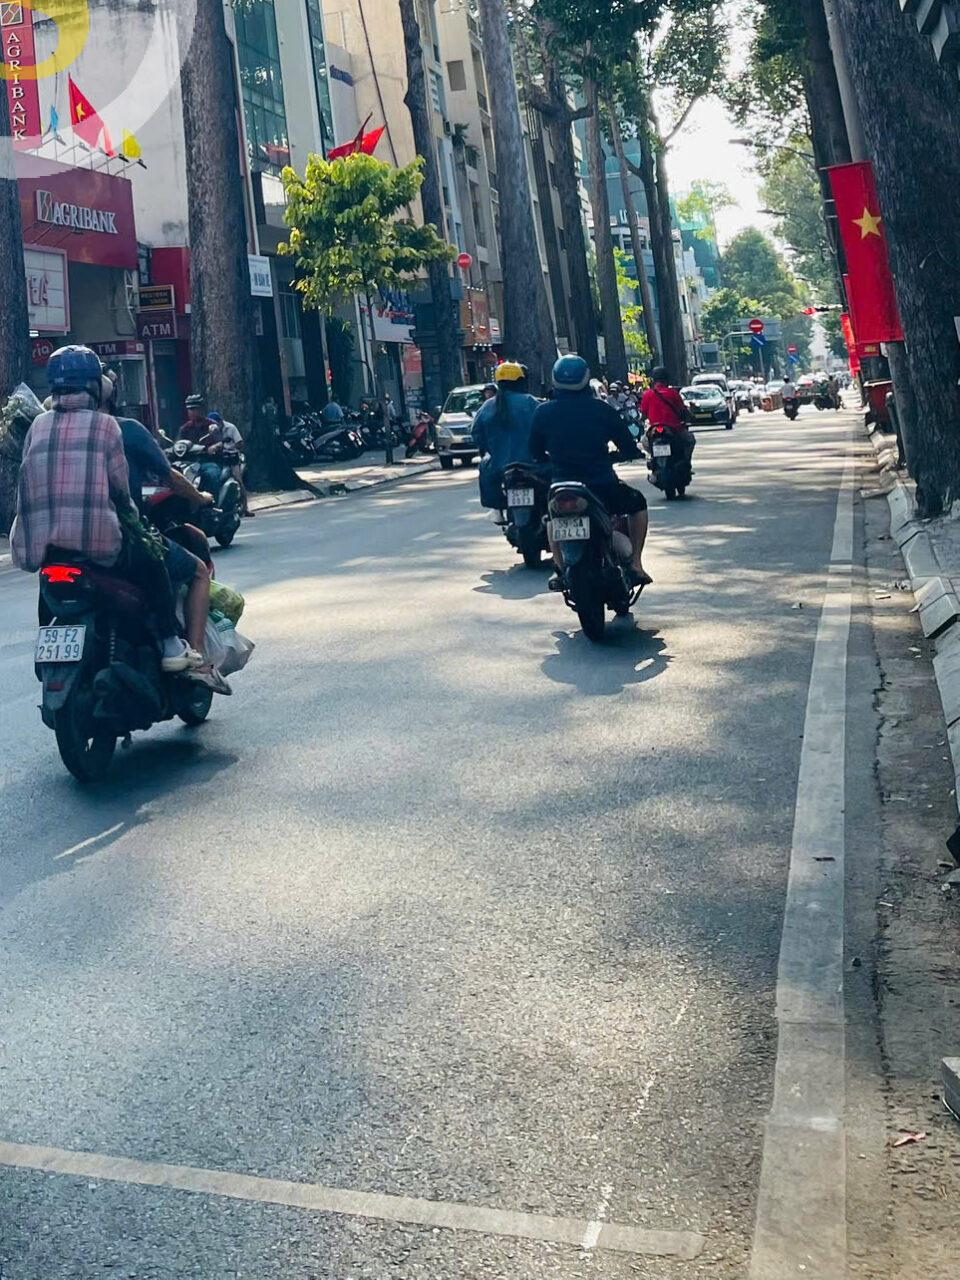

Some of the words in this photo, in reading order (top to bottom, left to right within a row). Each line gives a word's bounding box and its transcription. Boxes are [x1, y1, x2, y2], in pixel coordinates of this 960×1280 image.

[6, 32, 27, 141] AGRIBANK
[53, 201, 119, 235] AGRIBANK
[142, 323, 171, 337] ATM
